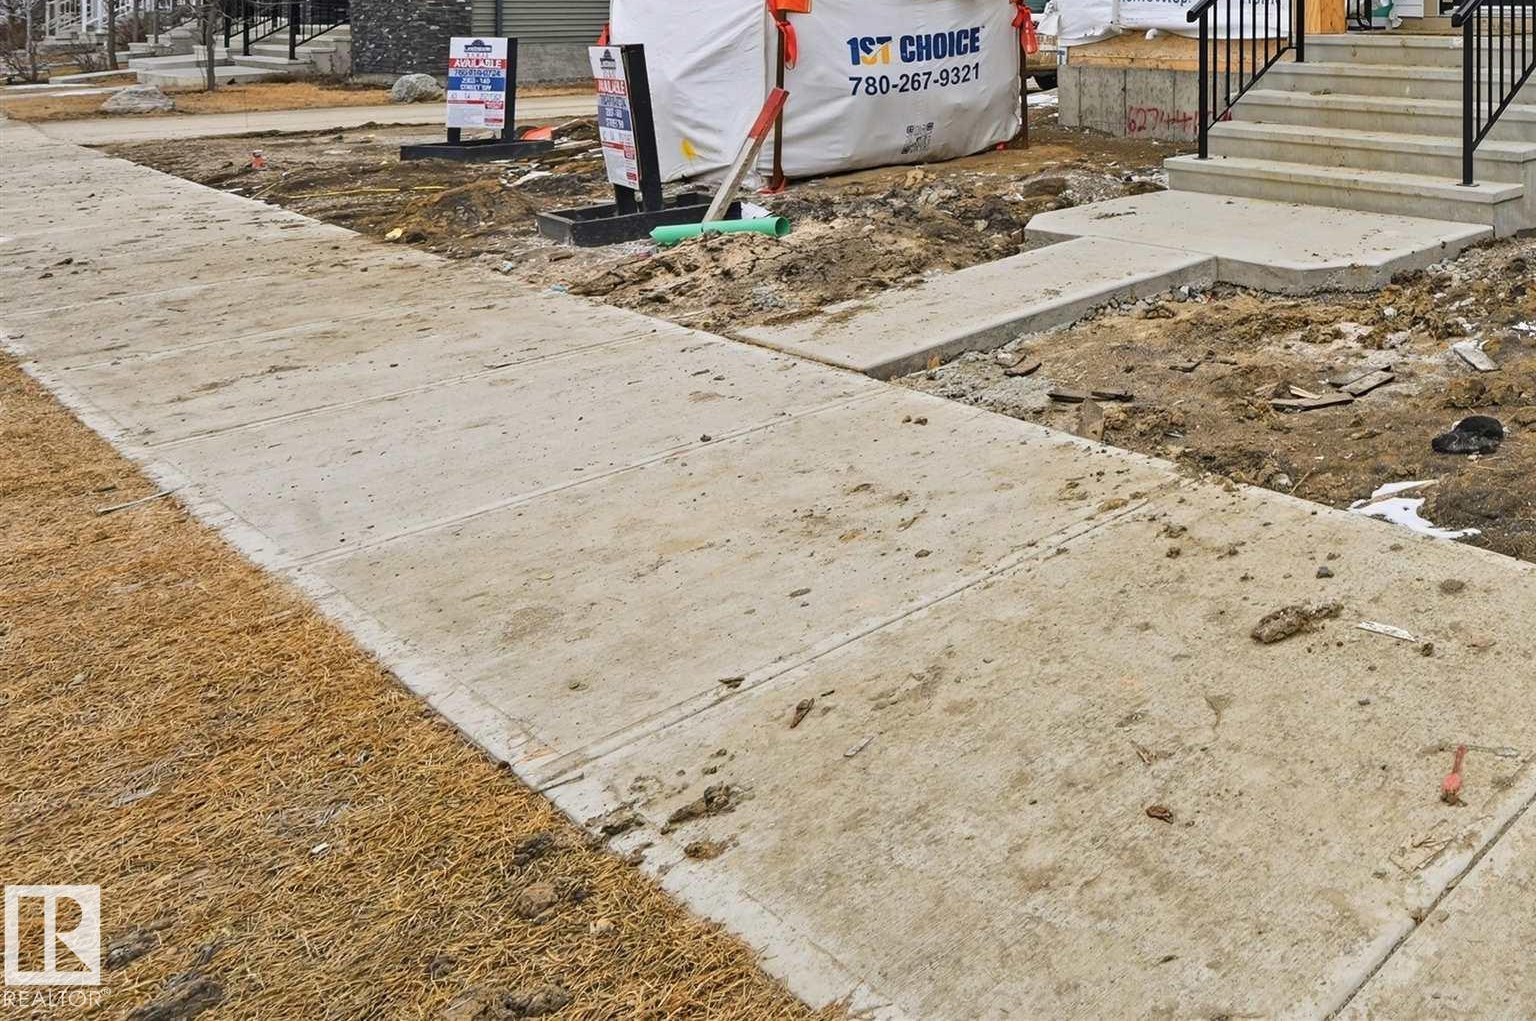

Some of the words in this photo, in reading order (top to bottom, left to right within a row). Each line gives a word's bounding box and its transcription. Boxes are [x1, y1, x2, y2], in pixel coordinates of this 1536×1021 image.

[847, 35, 892, 66] 1ST
[900, 26, 980, 63] CHOICE
[848, 62, 980, 96] 780-267-9321
